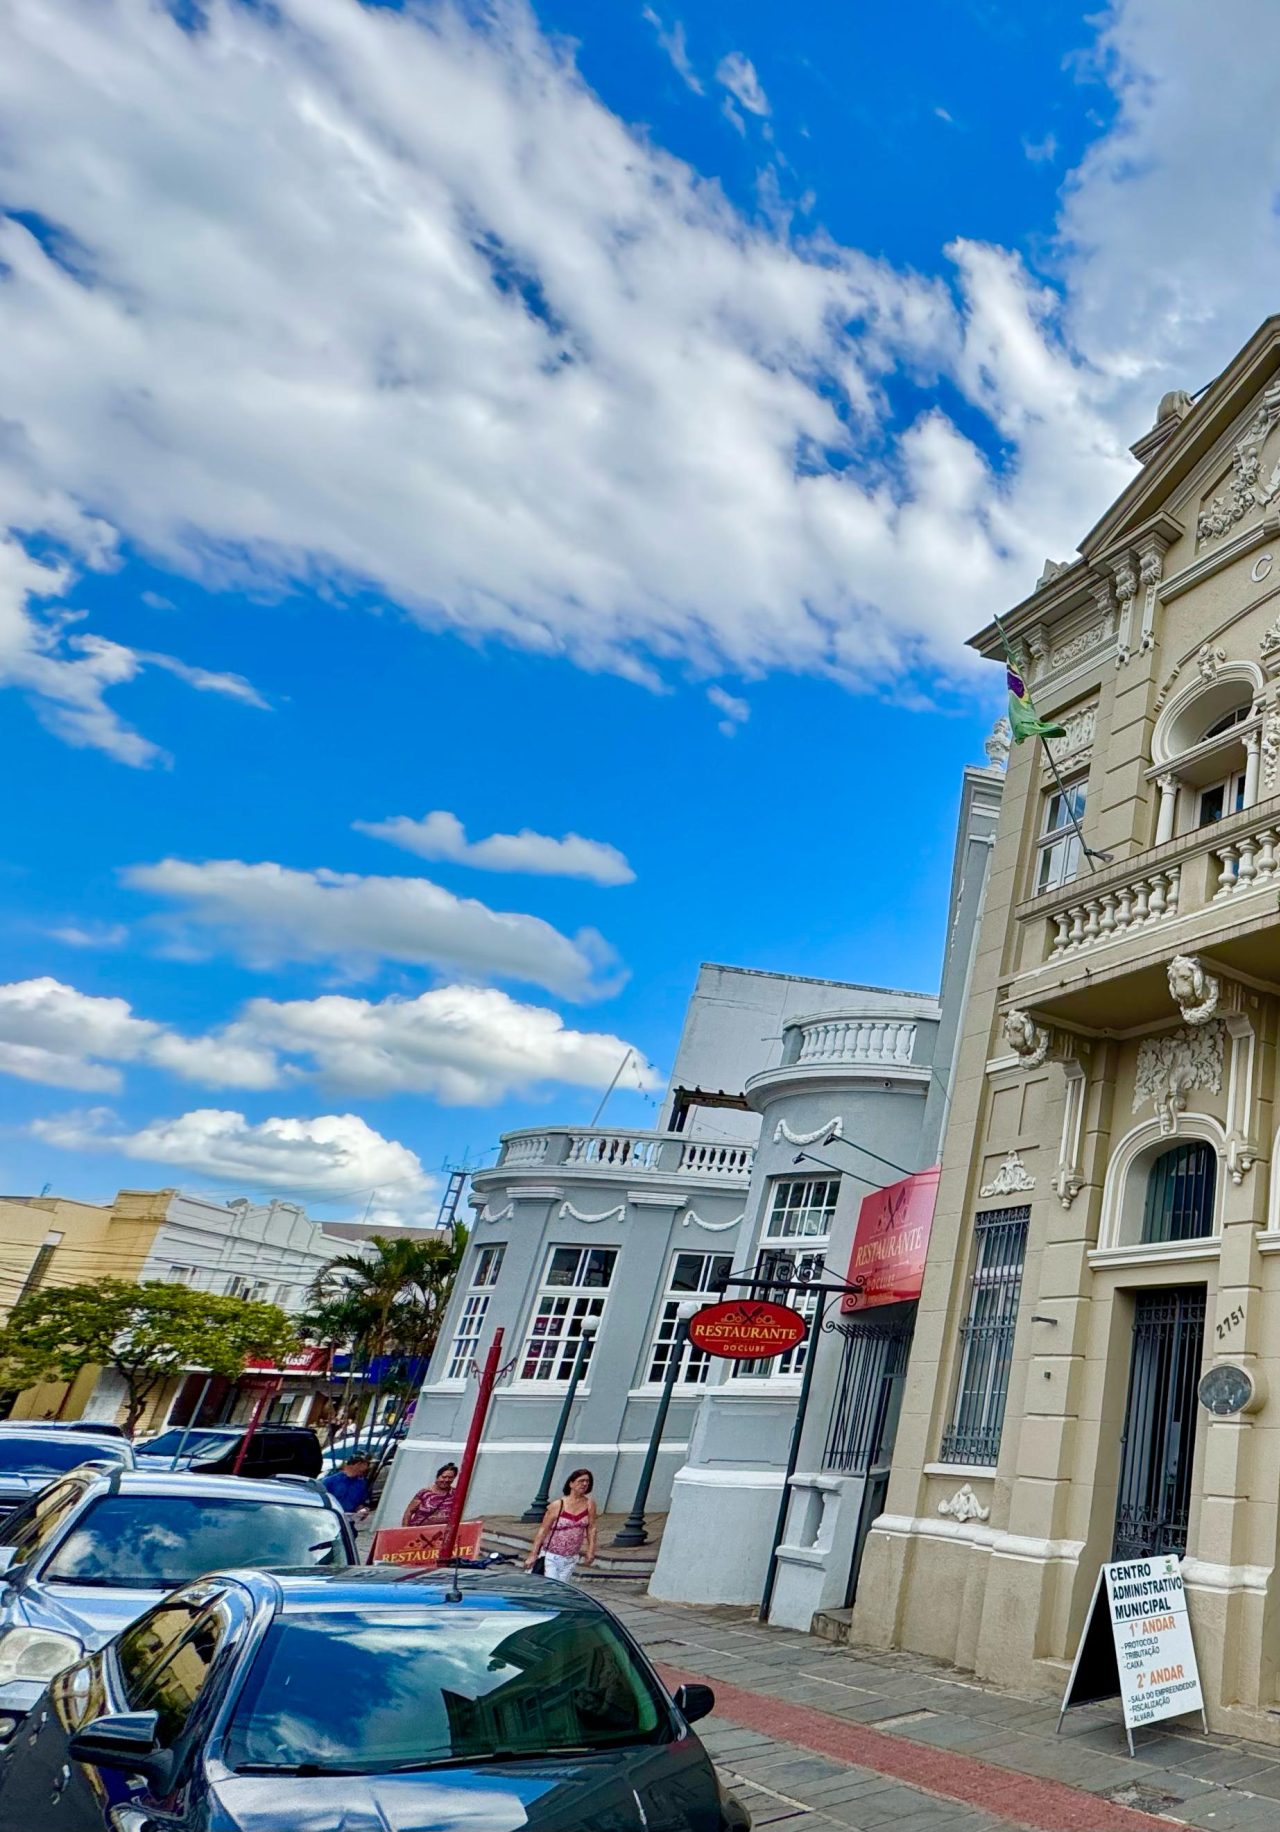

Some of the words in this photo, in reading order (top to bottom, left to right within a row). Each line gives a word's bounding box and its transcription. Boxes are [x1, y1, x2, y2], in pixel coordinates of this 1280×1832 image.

[855, 1226, 923, 1268] RESTAURANTE
[695, 1324, 797, 1340] RESTAURANTE
[1216, 1305, 1245, 1340] 2751
[382, 1545, 474, 1562] RESTAURNTE
[1110, 1563, 1151, 1582] CENTRO
[1112, 1576, 1183, 1601] ADMINISTRATIVO
[1115, 1597, 1171, 1620] MUNICIPAL
[1142, 1616, 1176, 1635] ANDAR
[1150, 1664, 1185, 1686] ANDAR
[1146, 1691, 1154, 1700] DO
[1155, 1680, 1197, 1698] EMPREENDEDOR
